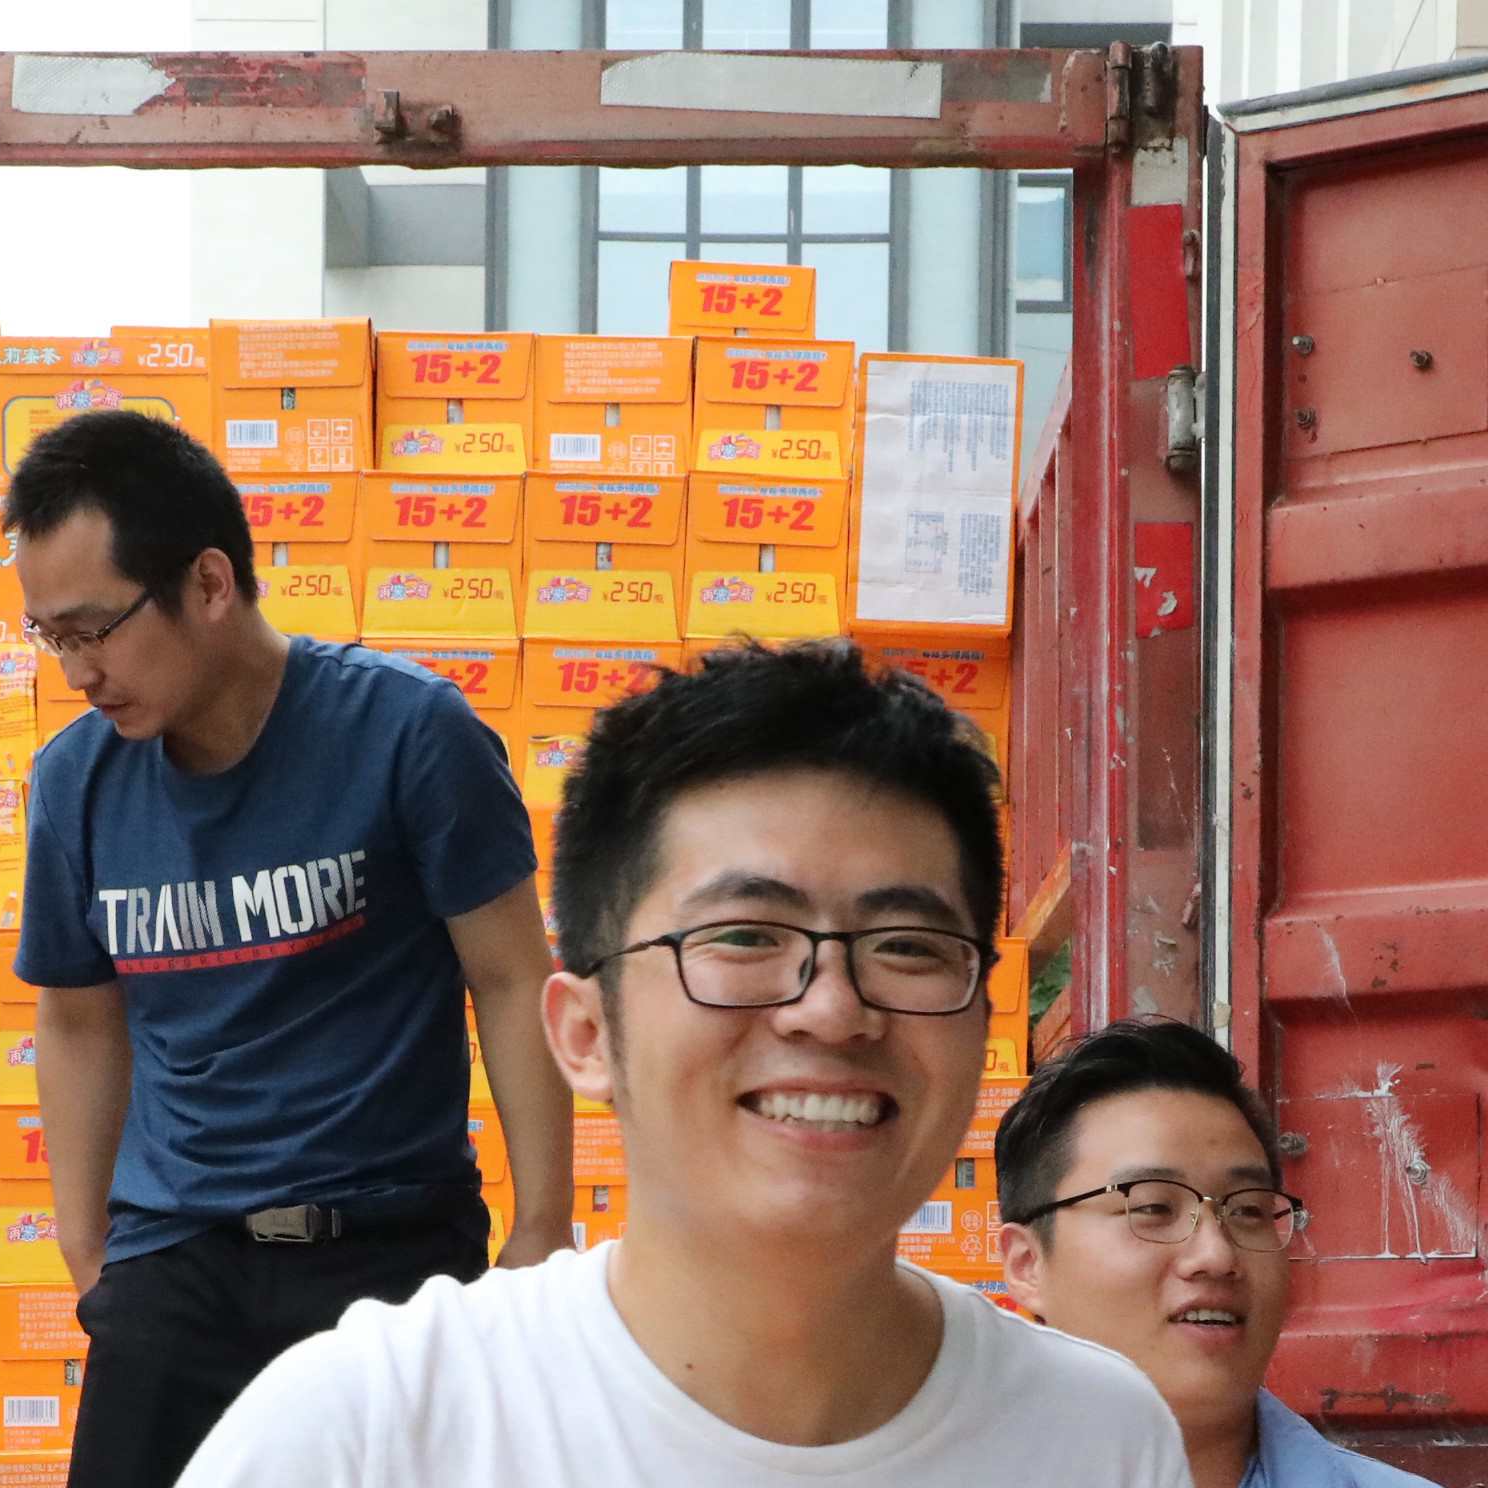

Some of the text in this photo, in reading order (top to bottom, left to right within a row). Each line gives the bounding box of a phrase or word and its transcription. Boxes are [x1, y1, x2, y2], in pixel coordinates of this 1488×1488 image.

[700, 286, 783, 317] 15+2
[412, 354, 501, 384] 15+2
[730, 362, 820, 392] 15+2
[395, 497, 487, 528] 15+2
[560, 495, 653, 528] 15+2
[724, 499, 815, 531] 15+2
[99, 881, 224, 955] TRAIN
[232, 850, 366, 942] MORE
